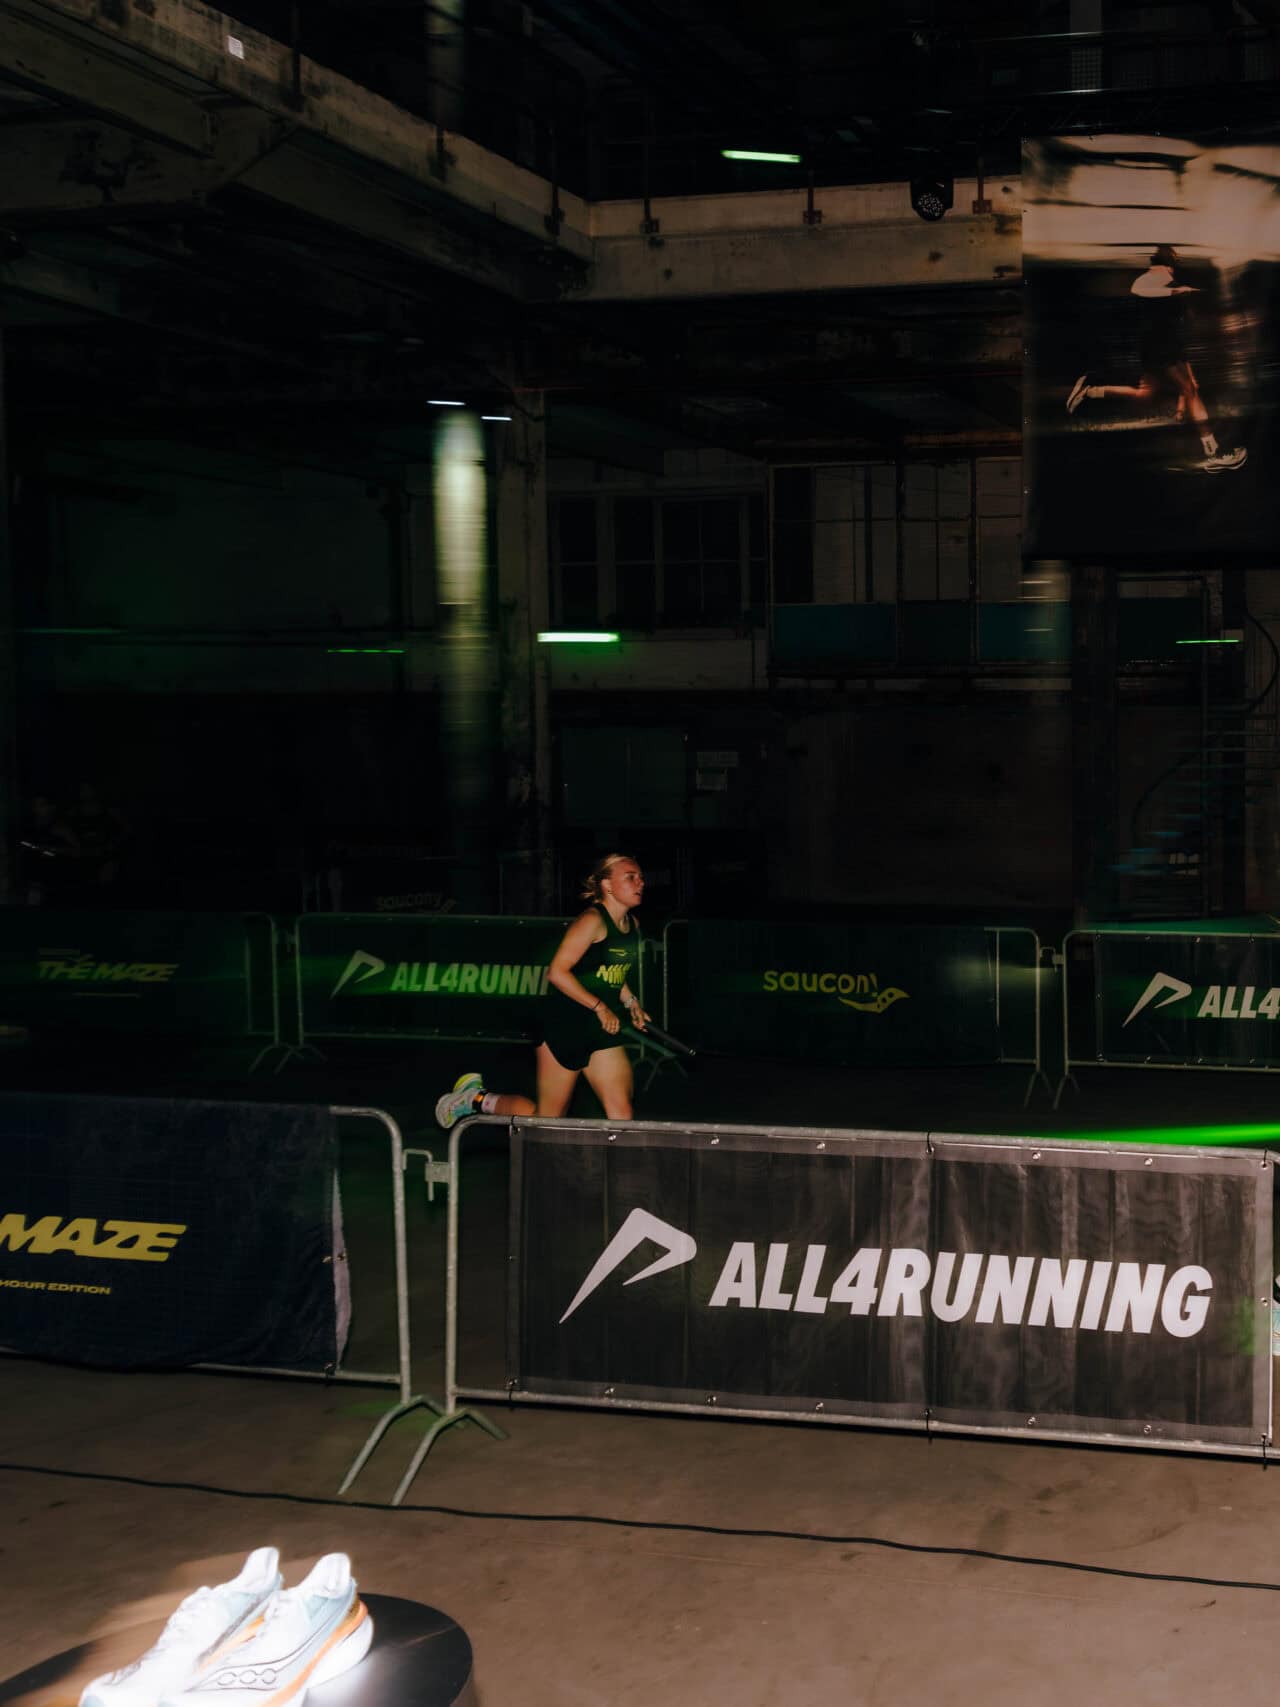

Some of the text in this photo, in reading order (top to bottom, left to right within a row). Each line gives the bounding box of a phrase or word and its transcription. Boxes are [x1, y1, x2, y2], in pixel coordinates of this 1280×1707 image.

[389, 961, 549, 996] ALL4RUNNI
[0, 1213, 188, 1262] MAZE
[47, 1282, 112, 1295] EDITION
[707, 1241, 1213, 1338] ALL4RUNNING
